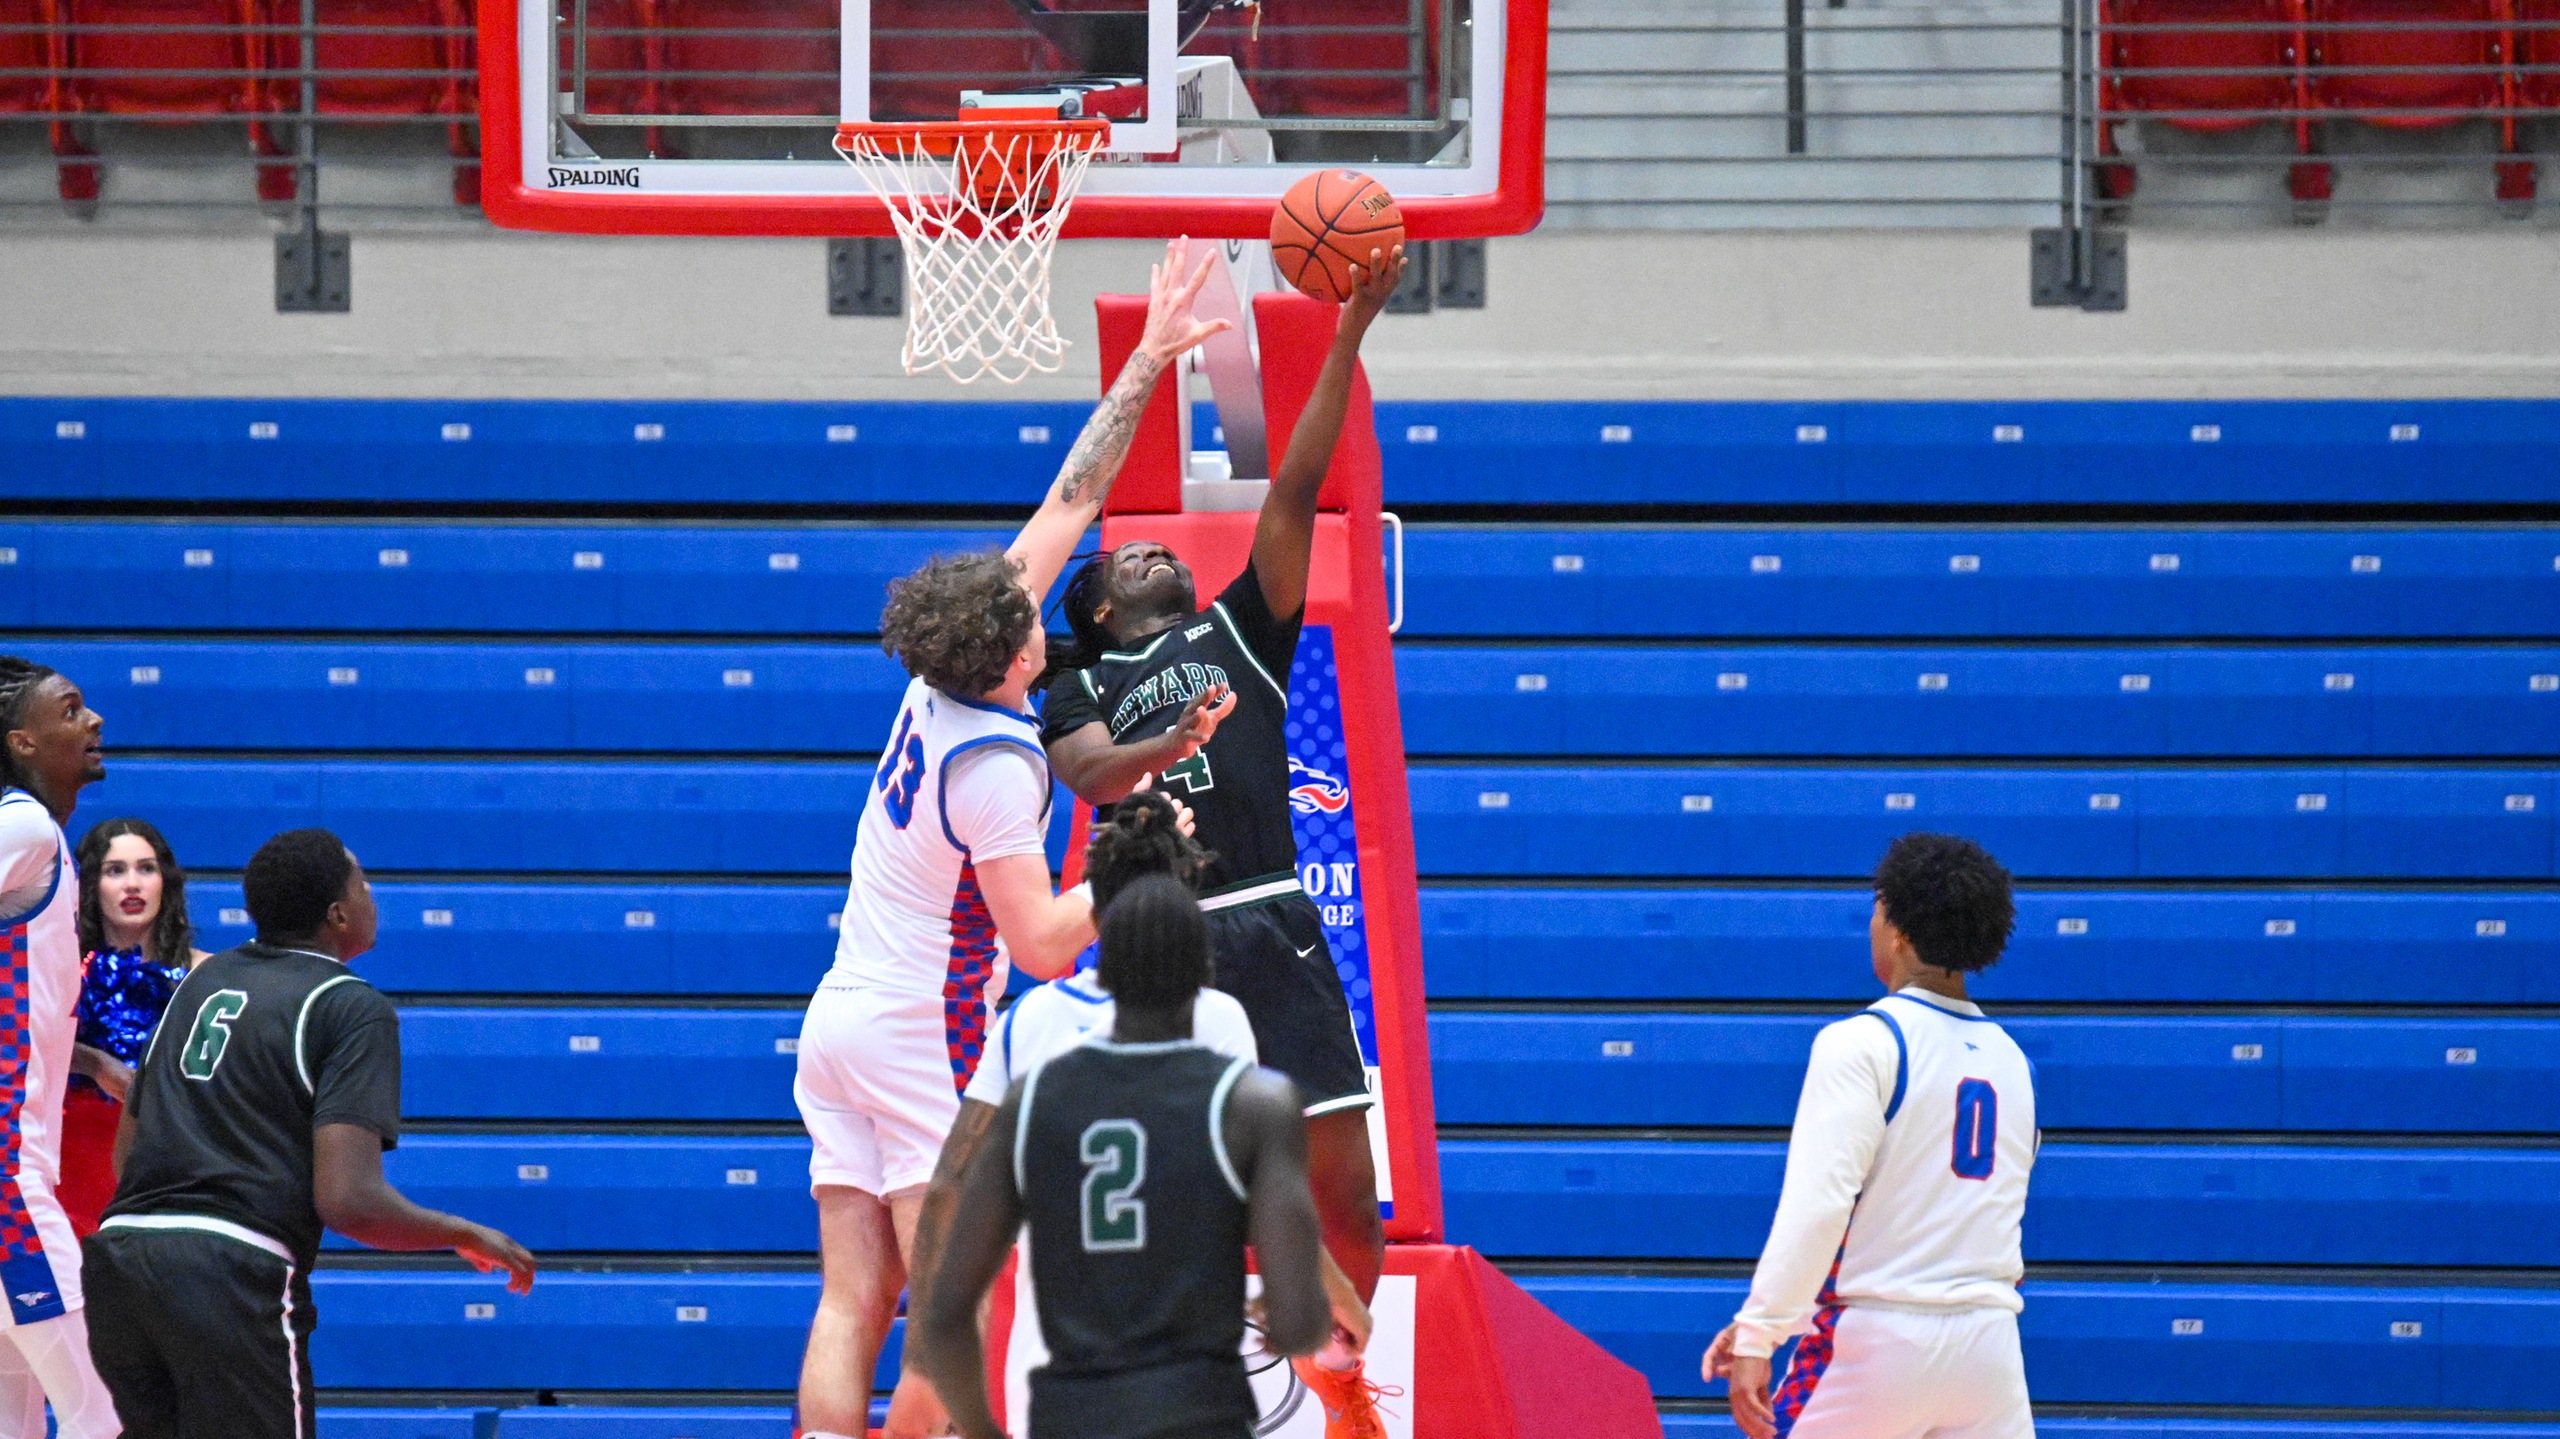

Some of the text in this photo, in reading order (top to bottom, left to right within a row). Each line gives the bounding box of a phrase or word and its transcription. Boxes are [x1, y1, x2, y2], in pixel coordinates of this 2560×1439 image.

[547, 167, 640, 188] SPALDING
[1184, 622, 1213, 643] KJCCC
[877, 705, 926, 830] 13
[1295, 862, 1356, 897] ON
[180, 988, 248, 1081] 6
[1951, 1076, 1998, 1182] 0
[1080, 1118, 1148, 1252] 2
